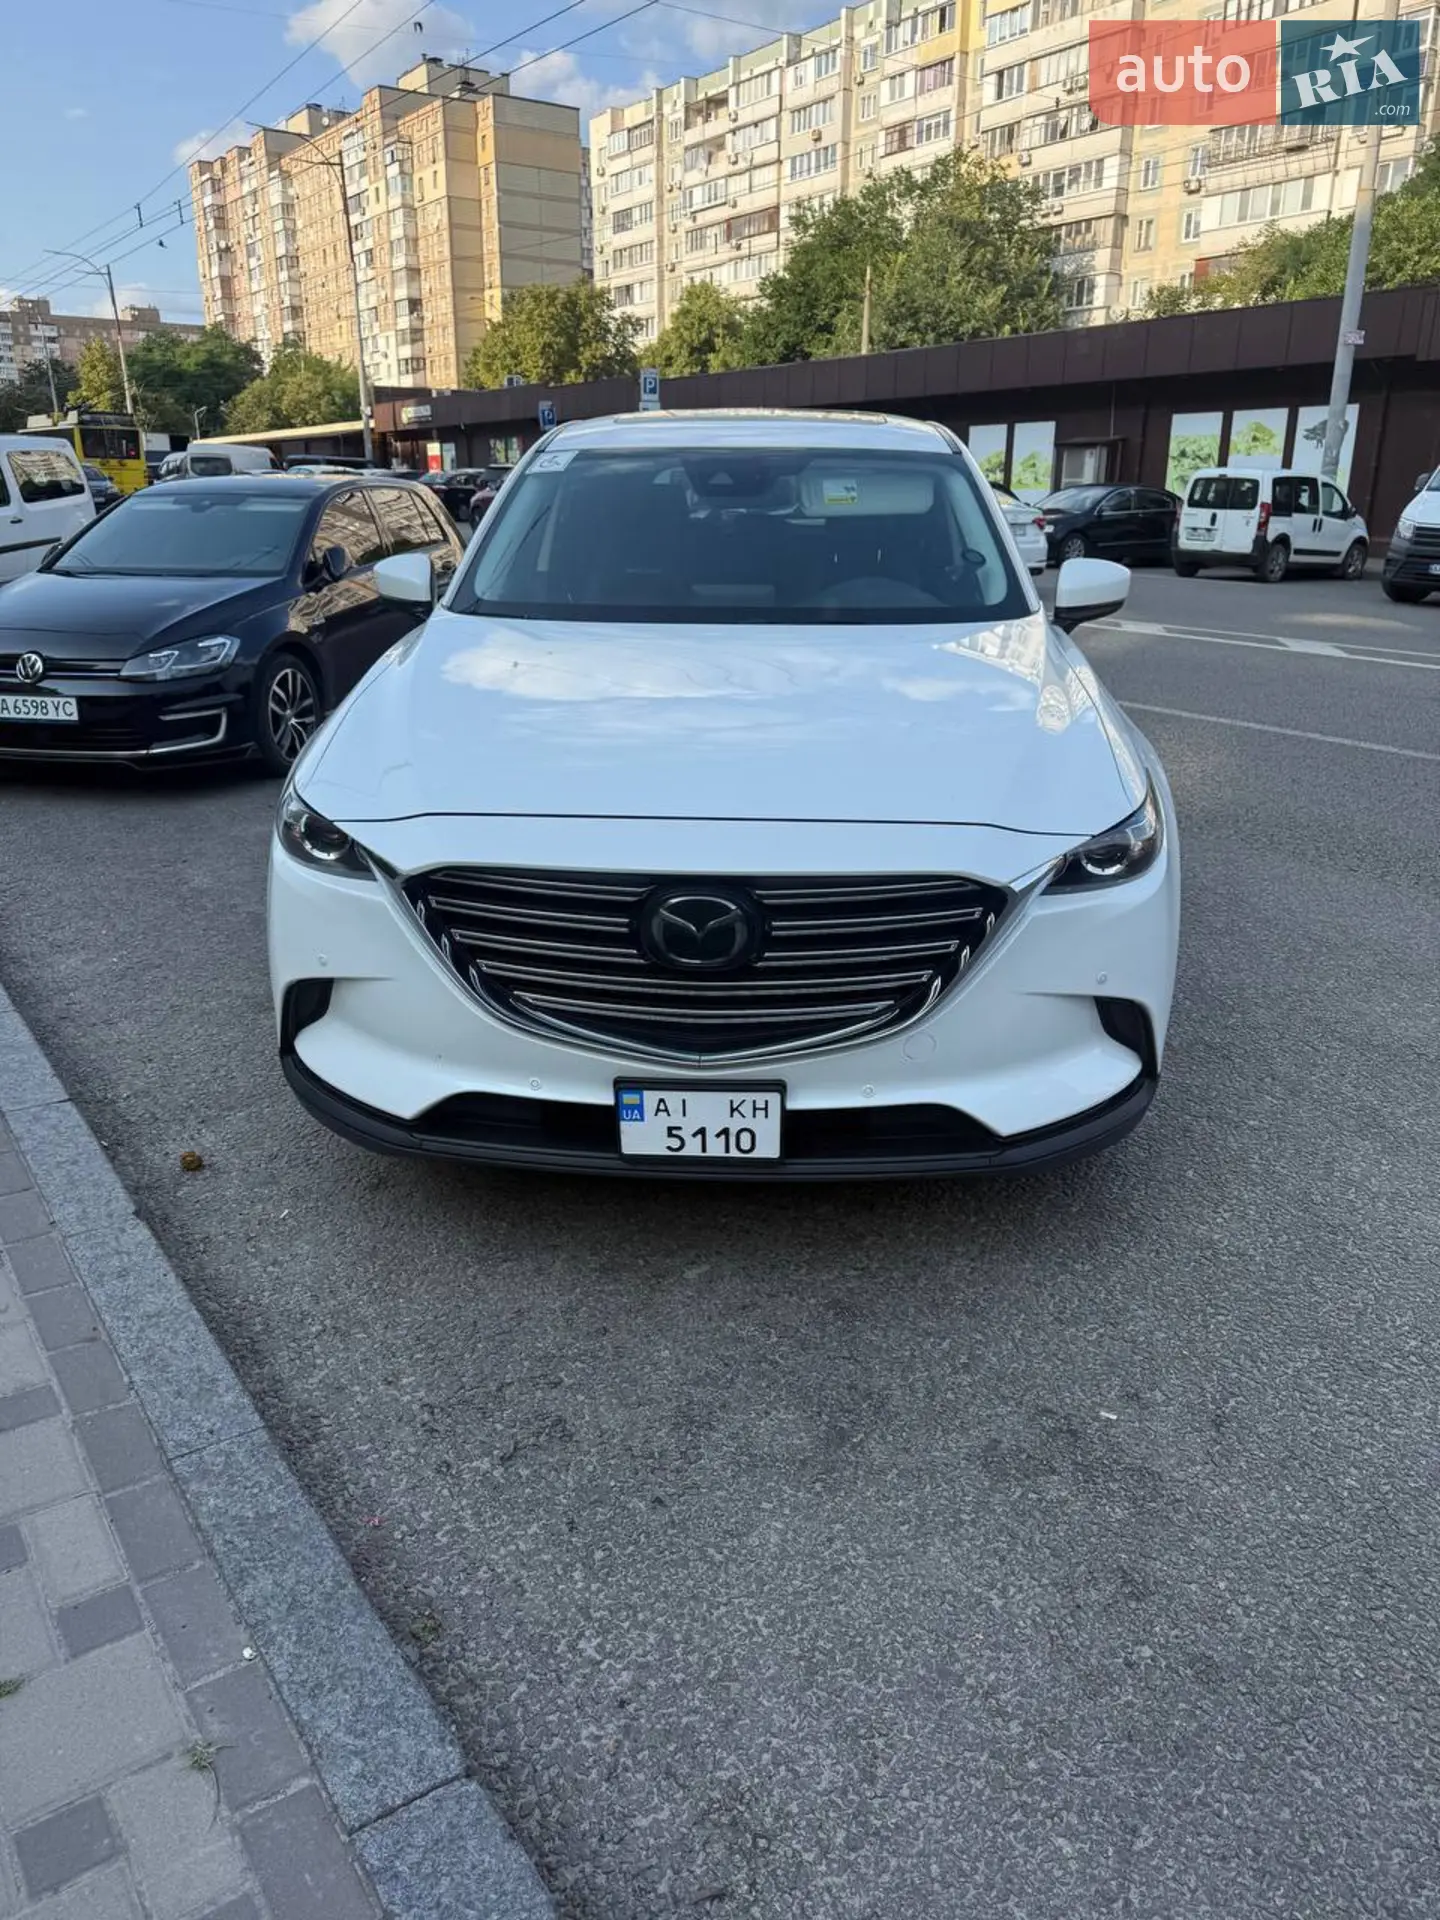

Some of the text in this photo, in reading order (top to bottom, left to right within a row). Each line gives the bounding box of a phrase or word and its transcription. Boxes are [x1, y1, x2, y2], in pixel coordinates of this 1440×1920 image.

[645, 378, 655, 393] P
[13, 699, 49, 716] 6598
[51, 700, 74, 717] YC
[622, 1111, 641, 1121] UA
[654, 1098, 769, 1119] AI KH
[665, 1125, 757, 1155] 5110
